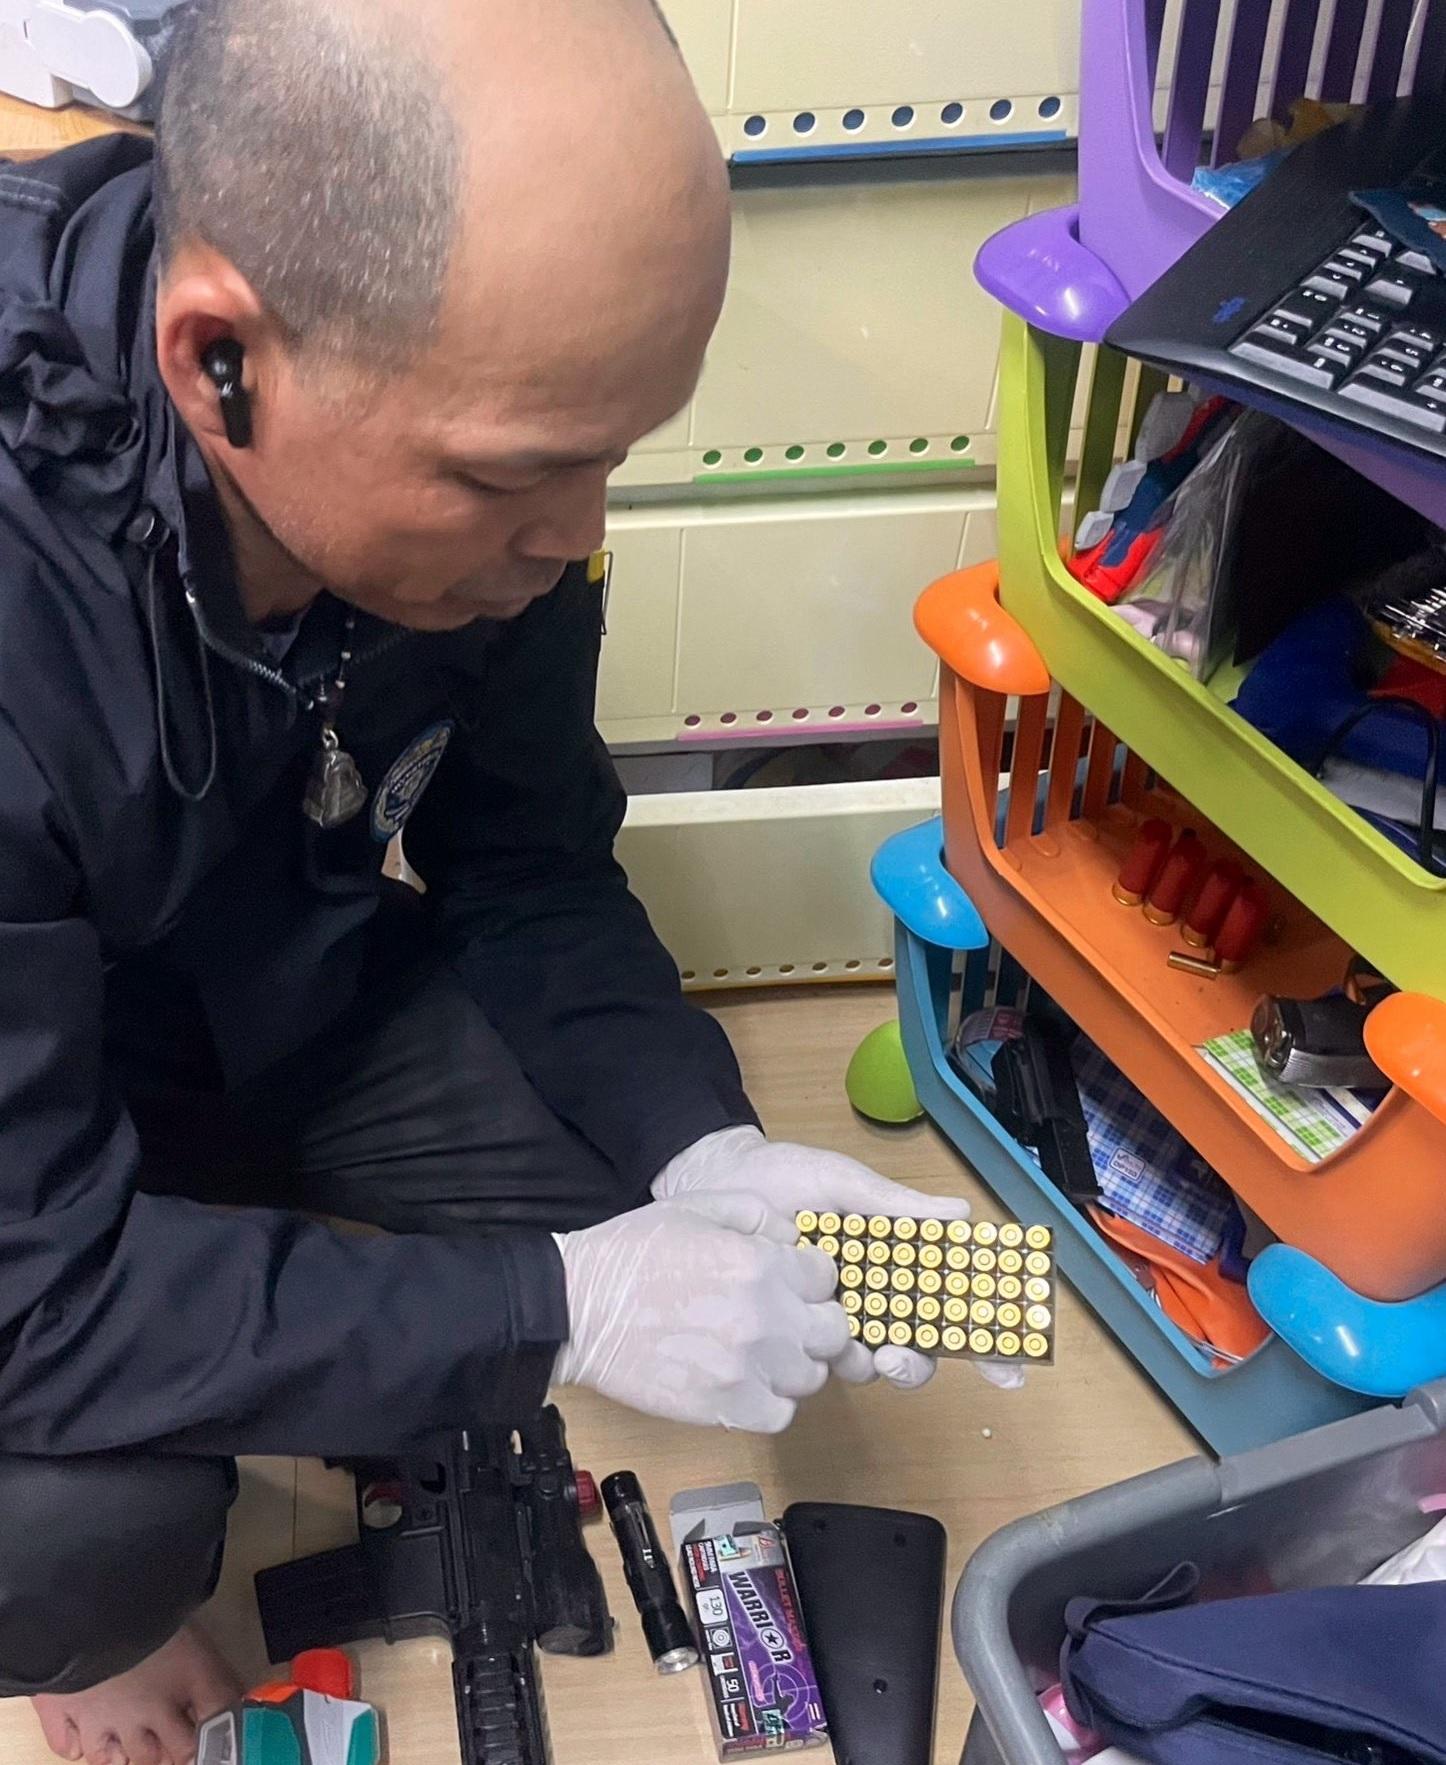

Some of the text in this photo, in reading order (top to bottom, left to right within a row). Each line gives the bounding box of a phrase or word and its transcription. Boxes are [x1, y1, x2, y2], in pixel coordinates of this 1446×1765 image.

[709, 1596, 723, 1616] 130
[728, 1571, 791, 1662] WARRIOR
[726, 1679, 740, 1692] 50
